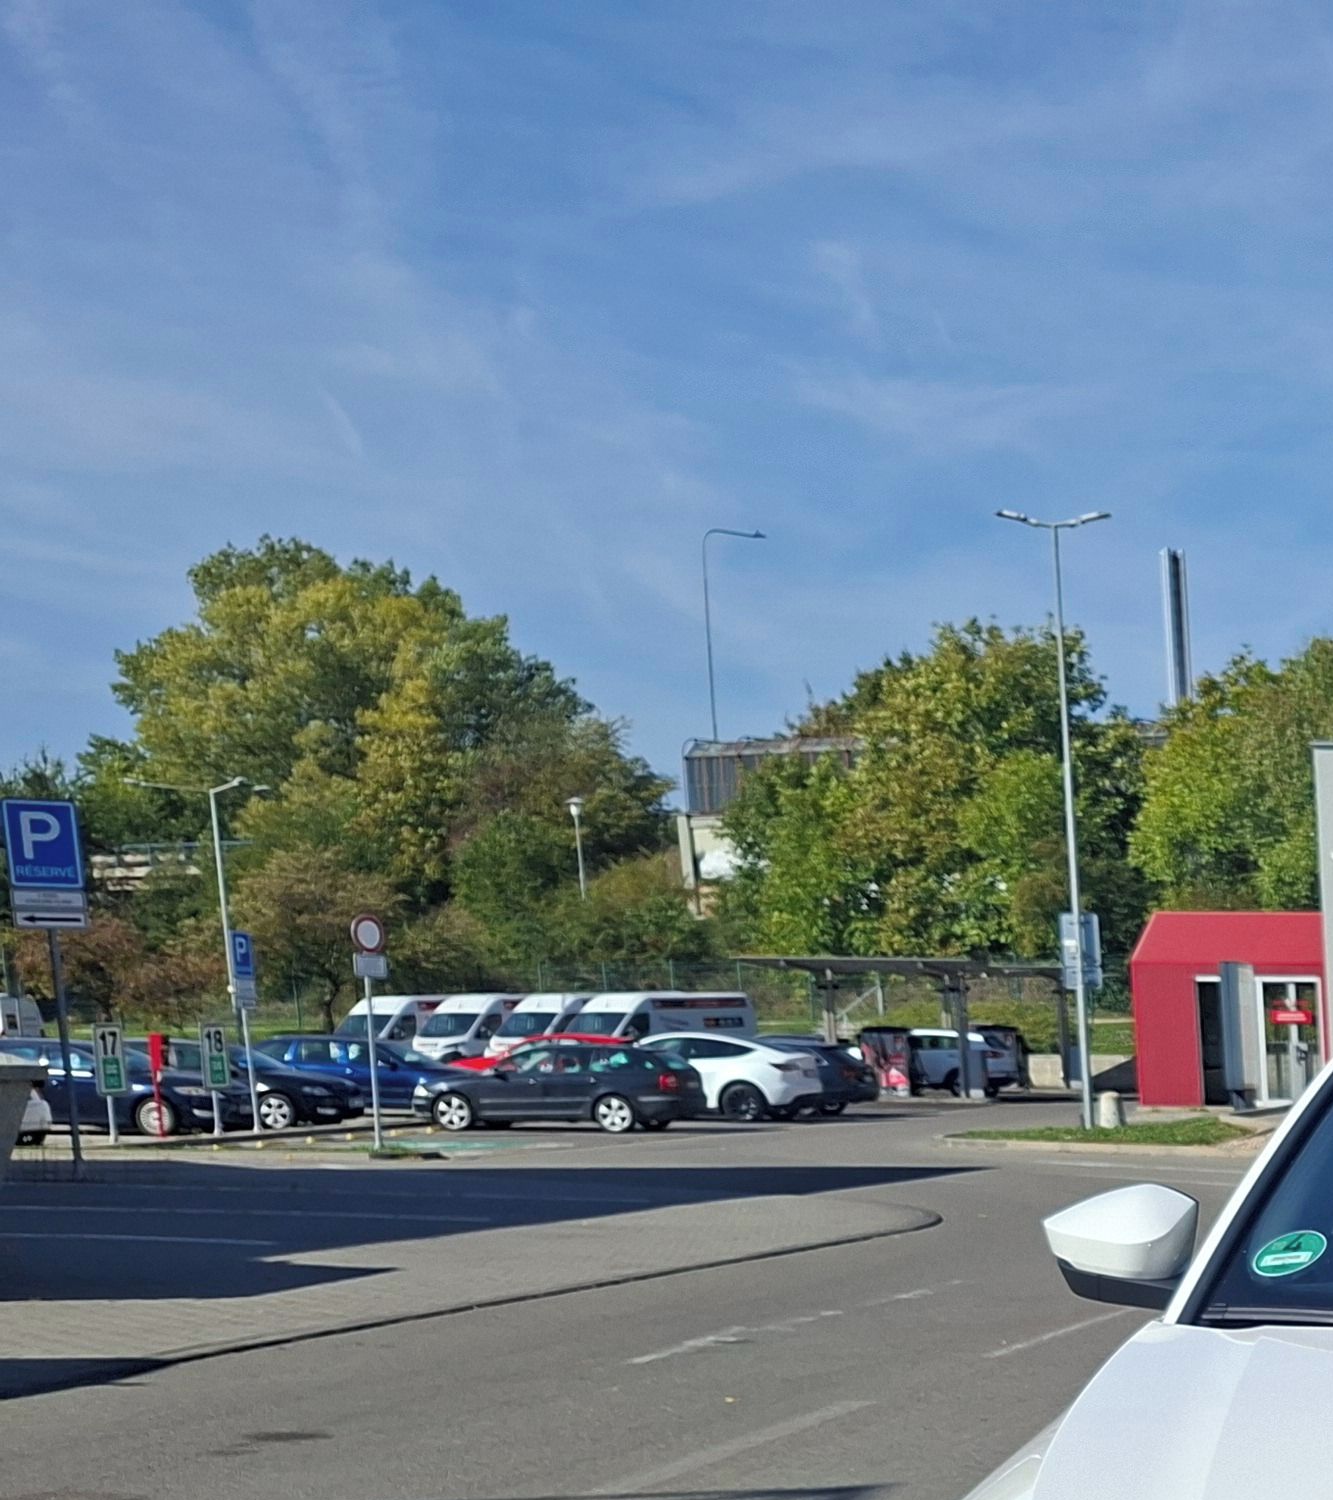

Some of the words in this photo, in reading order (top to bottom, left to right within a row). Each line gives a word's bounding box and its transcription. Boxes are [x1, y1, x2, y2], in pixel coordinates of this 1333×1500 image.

[20, 811, 60, 859] P
[234, 936, 247, 962] P
[99, 1030, 117, 1056] 17
[205, 1030, 223, 1053] 18
